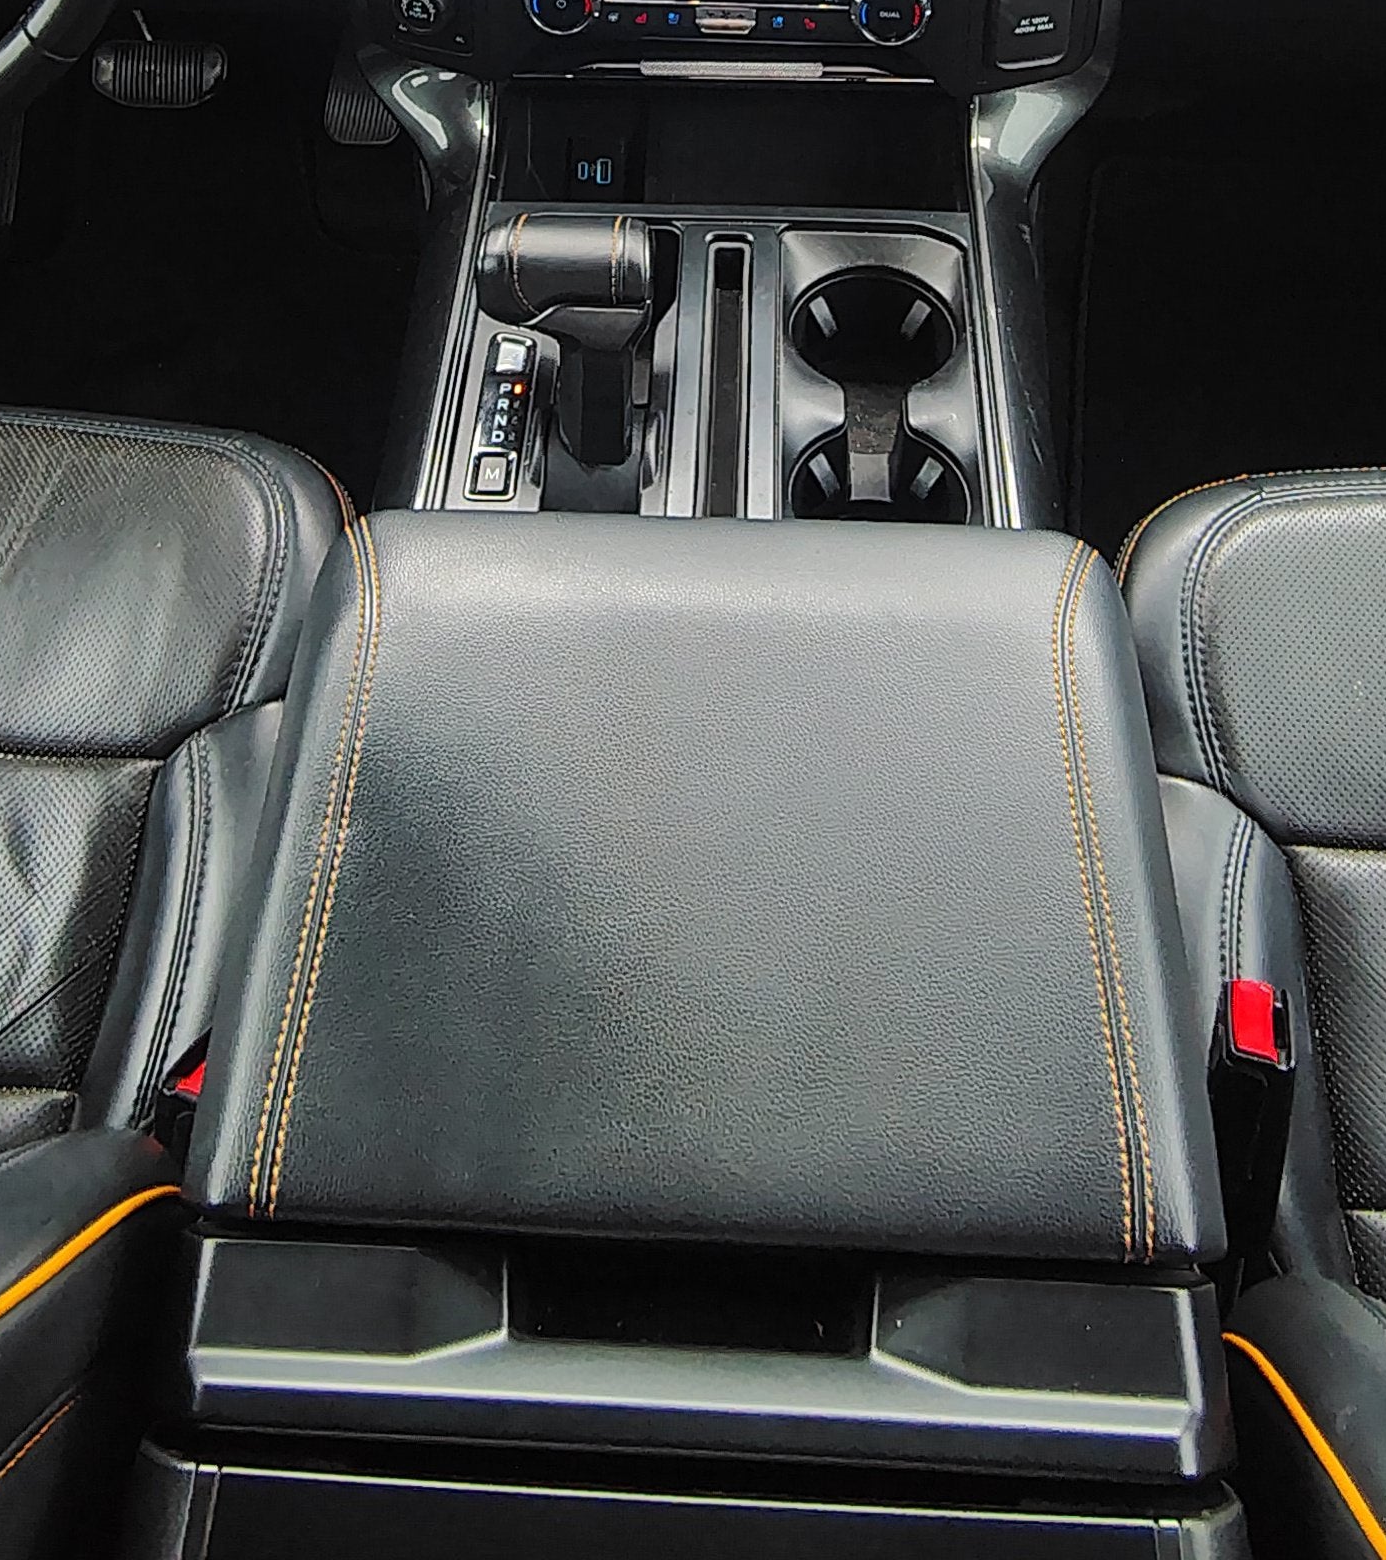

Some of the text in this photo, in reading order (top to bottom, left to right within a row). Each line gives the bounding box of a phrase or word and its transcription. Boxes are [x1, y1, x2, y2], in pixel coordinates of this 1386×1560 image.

[879, 10, 901, 19] DUAL
[499, 383, 512, 394] P
[497, 398, 511, 411] R
[494, 414, 508, 427] N
[491, 430, 505, 443] D
[484, 468, 501, 481] M
